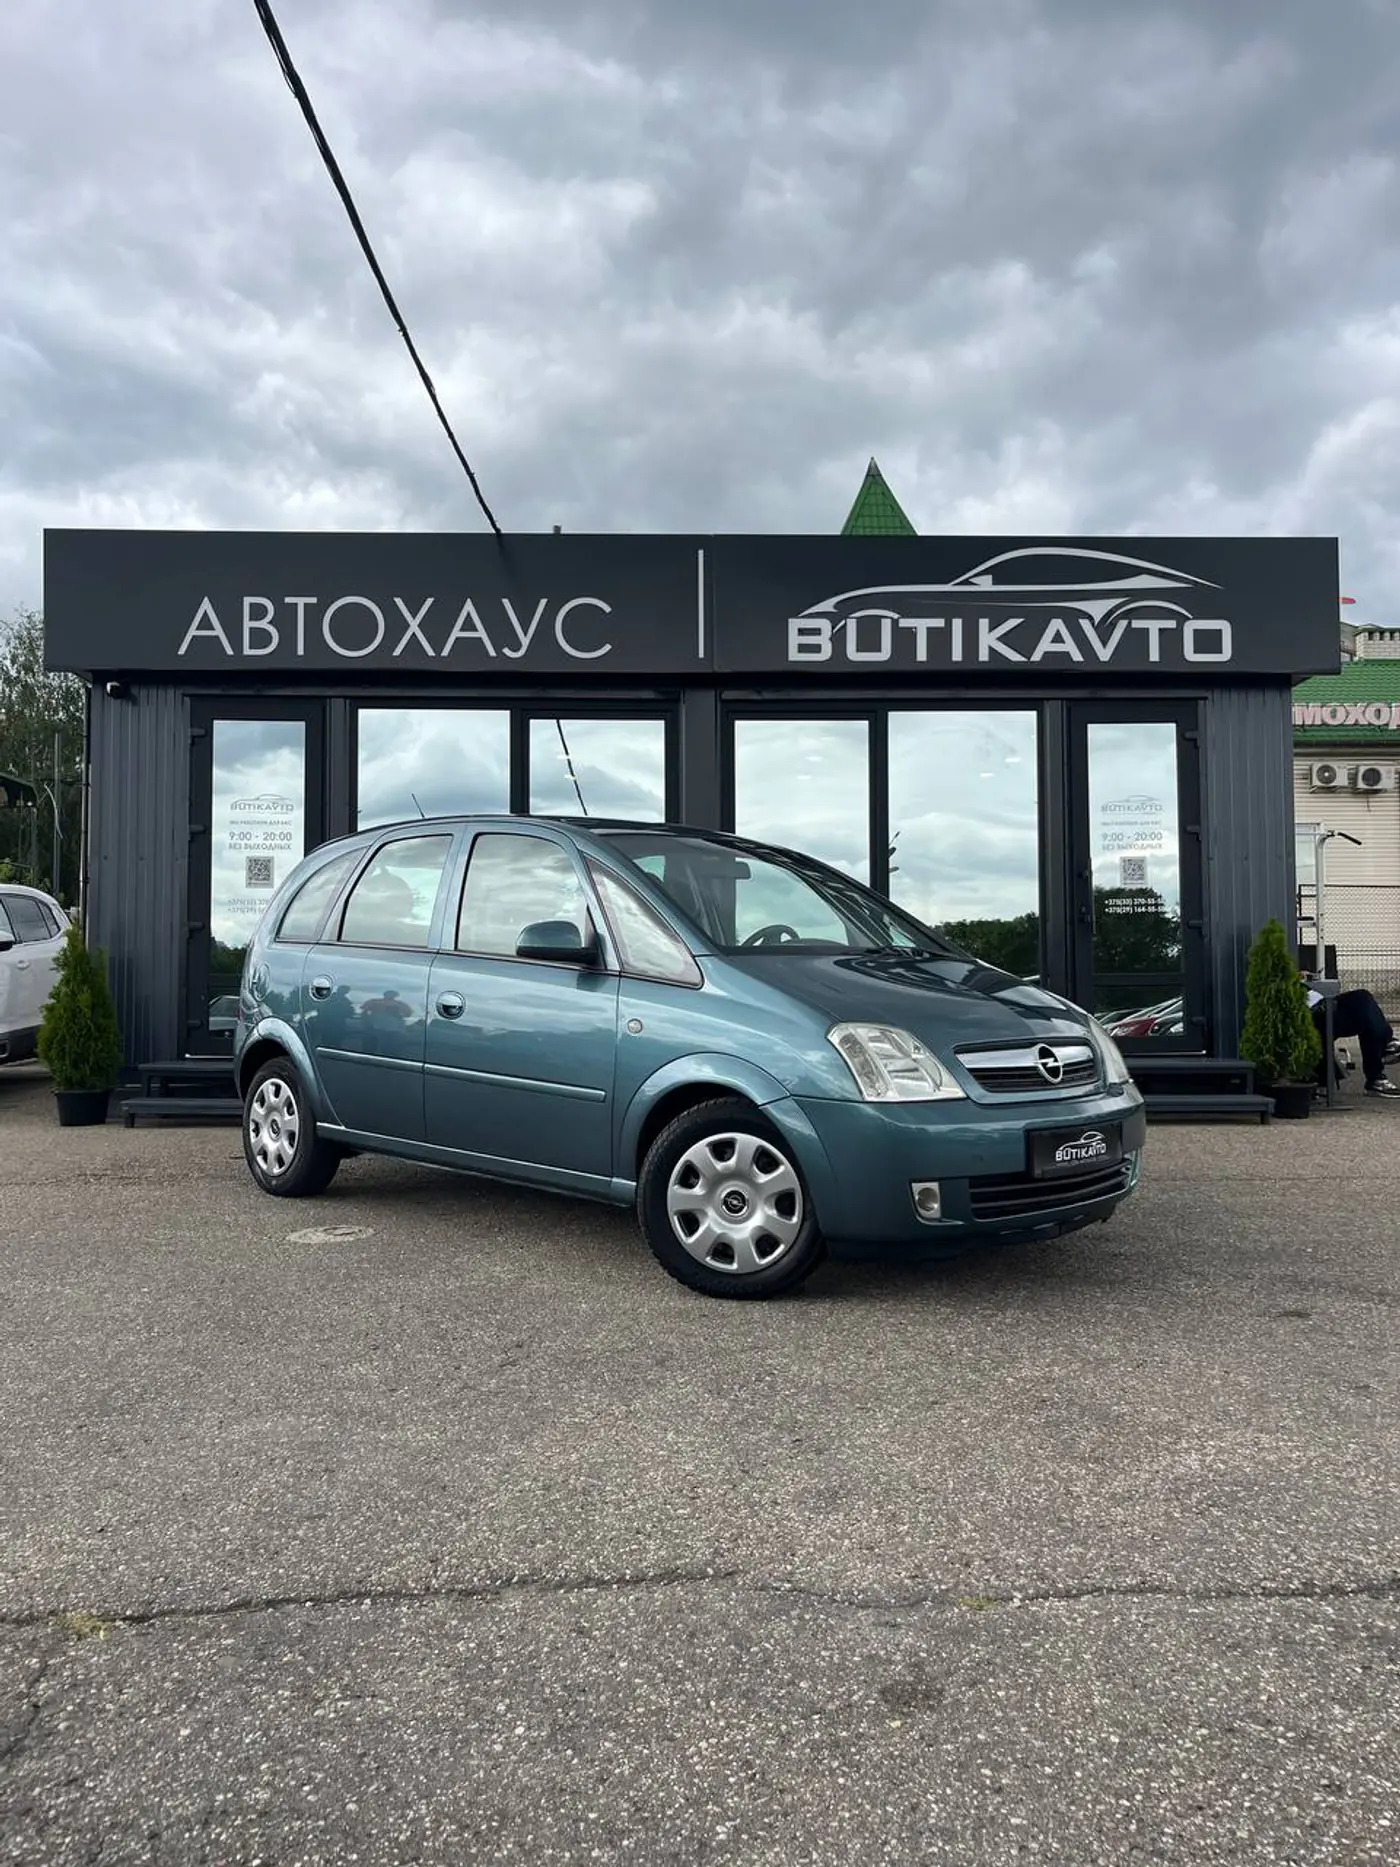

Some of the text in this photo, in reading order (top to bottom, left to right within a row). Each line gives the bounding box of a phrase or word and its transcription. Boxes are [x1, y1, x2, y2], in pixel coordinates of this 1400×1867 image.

[178, 595, 612, 659] АВТОХАУС
[788, 618, 1232, 662] BUTIKAVTO
[229, 831, 251, 841] 9:00
[262, 831, 292, 841] 20:00
[1102, 831, 1124, 842] 9:00
[1134, 831, 1163, 841] 20:00
[244, 842, 293, 851] ВЫХОДНЫХ
[1055, 1143, 1107, 1162] BUTIKAVTO
